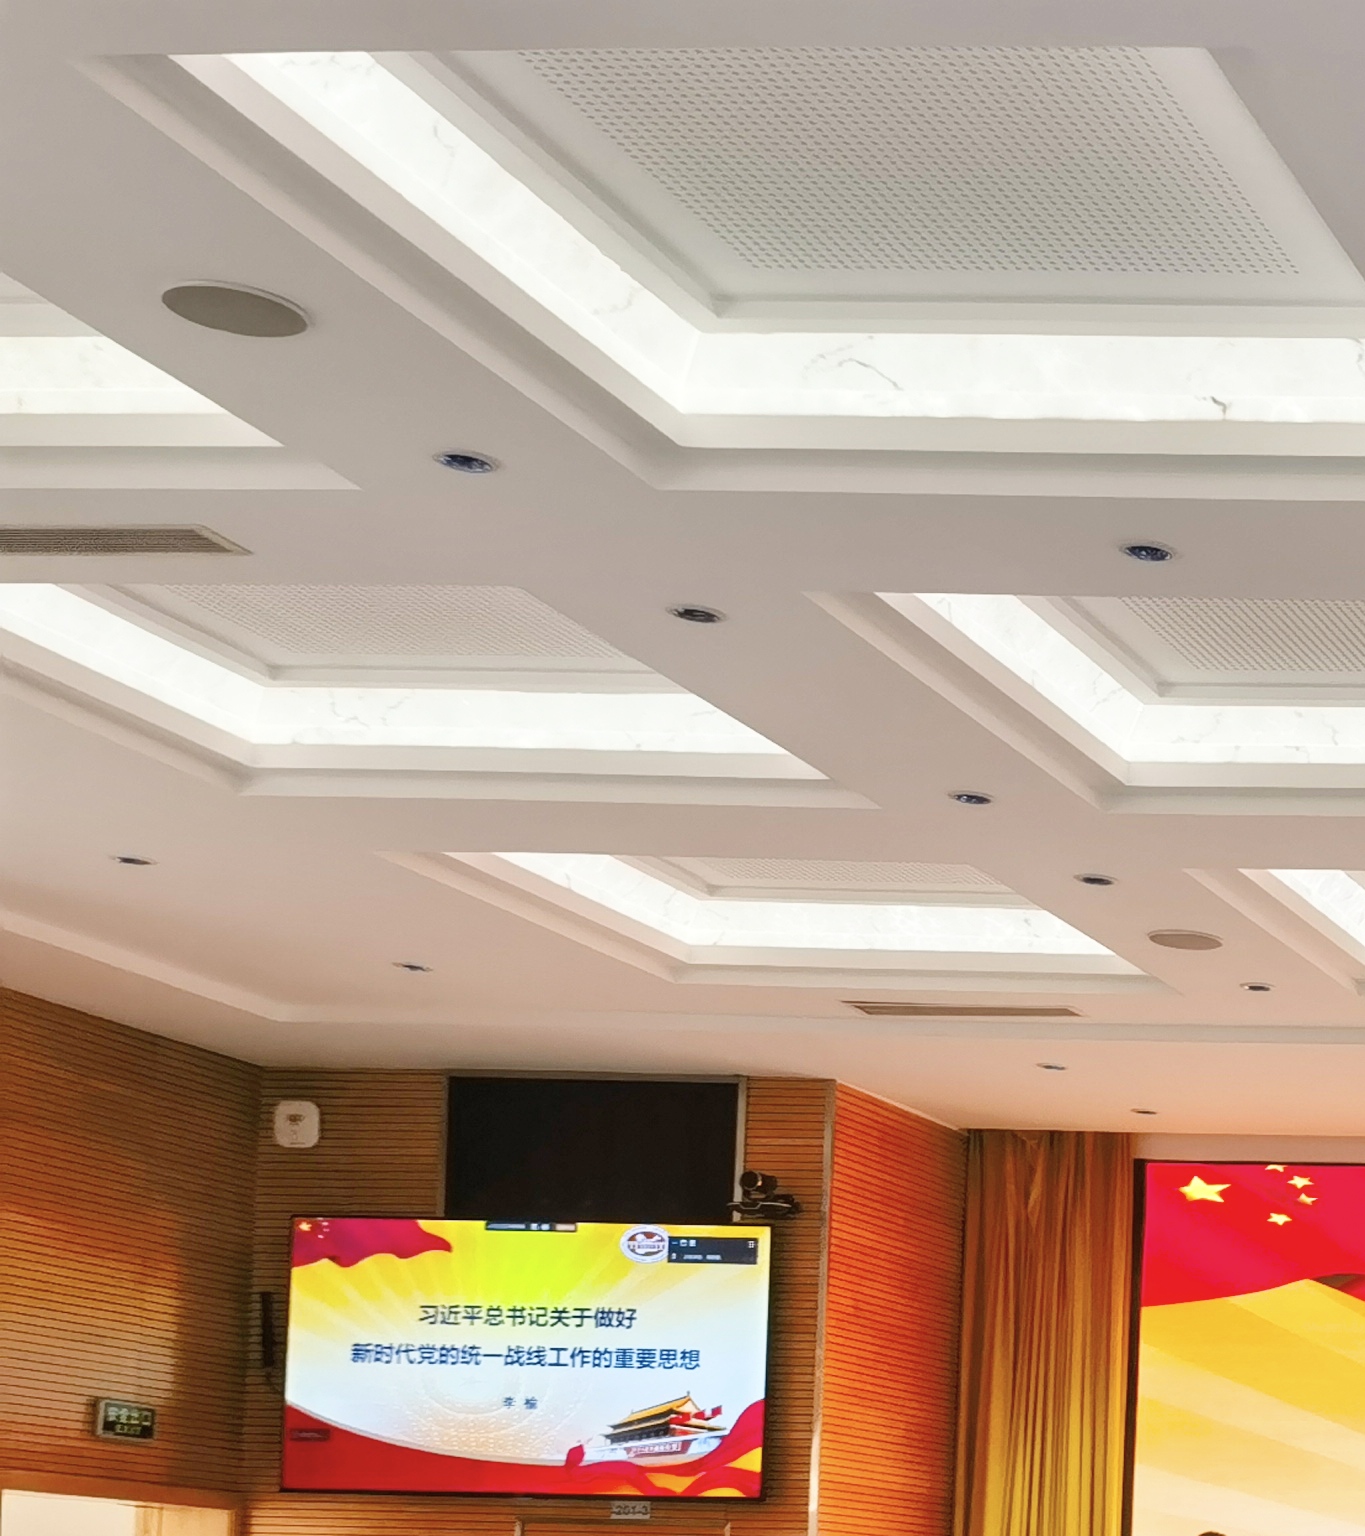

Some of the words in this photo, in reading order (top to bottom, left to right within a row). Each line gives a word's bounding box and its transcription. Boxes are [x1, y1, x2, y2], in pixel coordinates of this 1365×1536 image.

[419, 1304, 637, 1329] 习近平总书记关于做好
[350, 1343, 701, 1370] 新时代党的统一战线工作的重要思想
